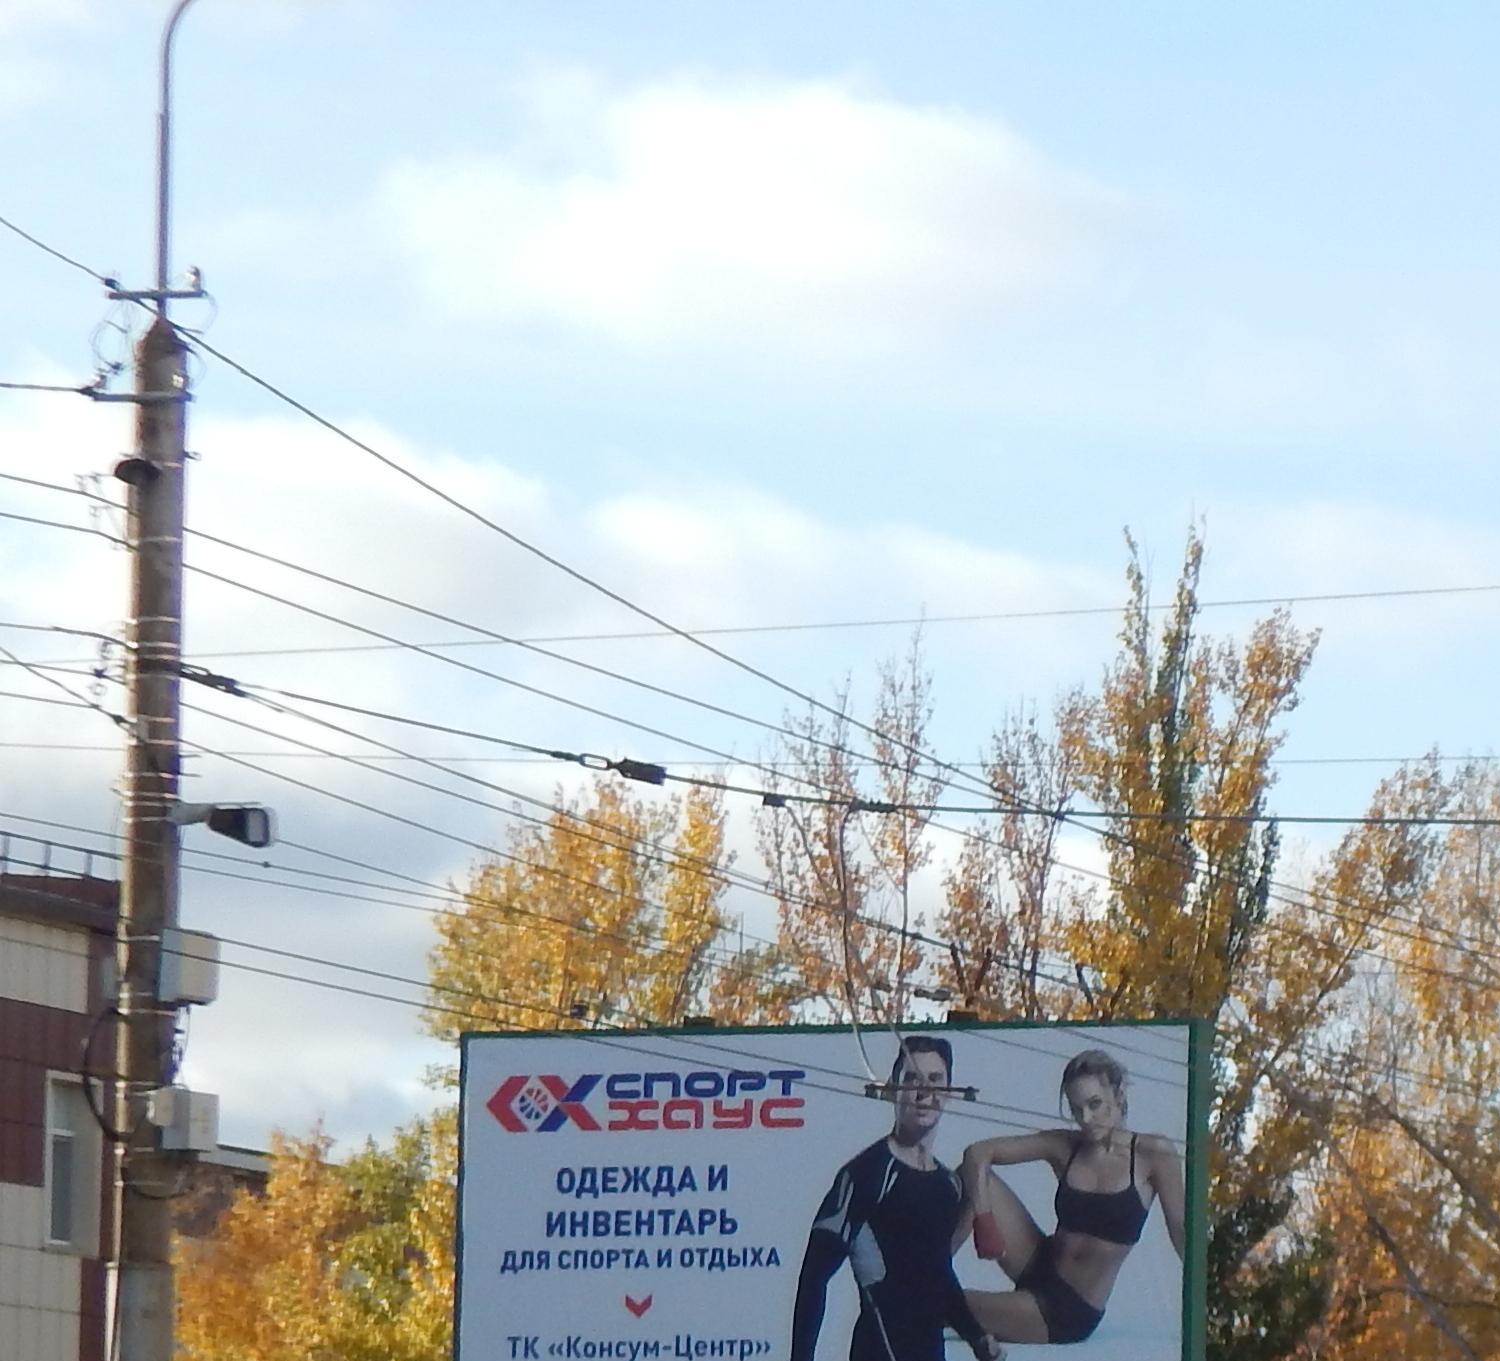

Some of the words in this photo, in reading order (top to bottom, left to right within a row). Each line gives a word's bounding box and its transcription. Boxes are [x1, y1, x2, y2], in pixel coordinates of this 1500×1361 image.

[606, 1070, 806, 1099] СПОРТ
[607, 1098, 806, 1131] ХАУС
[556, 1165, 698, 1199] ОДЕЖДА
[707, 1164, 729, 1192] И
[545, 1208, 739, 1238] ИНВЕНТАРЬ
[500, 1250, 550, 1275] ДЛЯ
[557, 1248, 650, 1271] СПОРТА
[656, 1248, 673, 1269] И
[679, 1247, 781, 1272] ОТДЫХА
[507, 1335, 540, 1360] ТК
